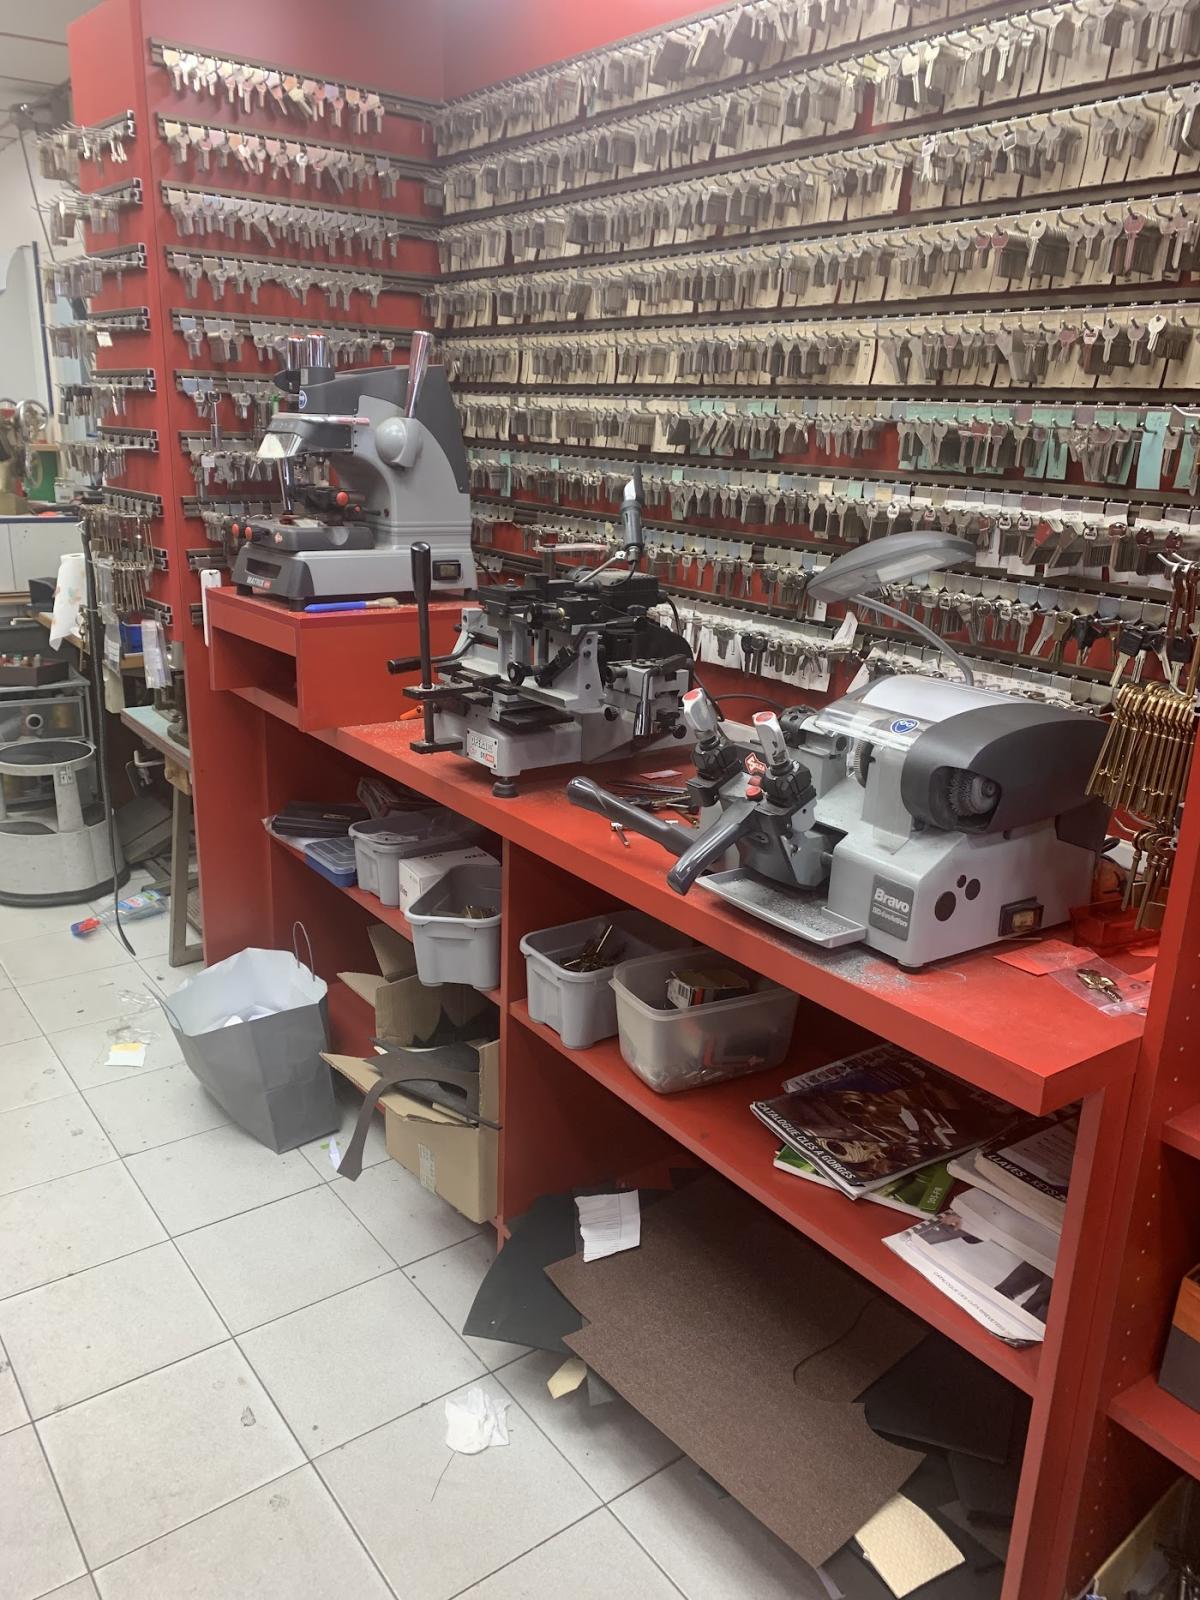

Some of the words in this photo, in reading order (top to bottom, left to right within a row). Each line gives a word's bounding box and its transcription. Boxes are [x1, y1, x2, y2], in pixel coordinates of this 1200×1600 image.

[874, 887, 910, 913] Bravo
[757, 1102, 800, 1137] CATALOGUE
[822, 1154, 857, 1180] GORGES
